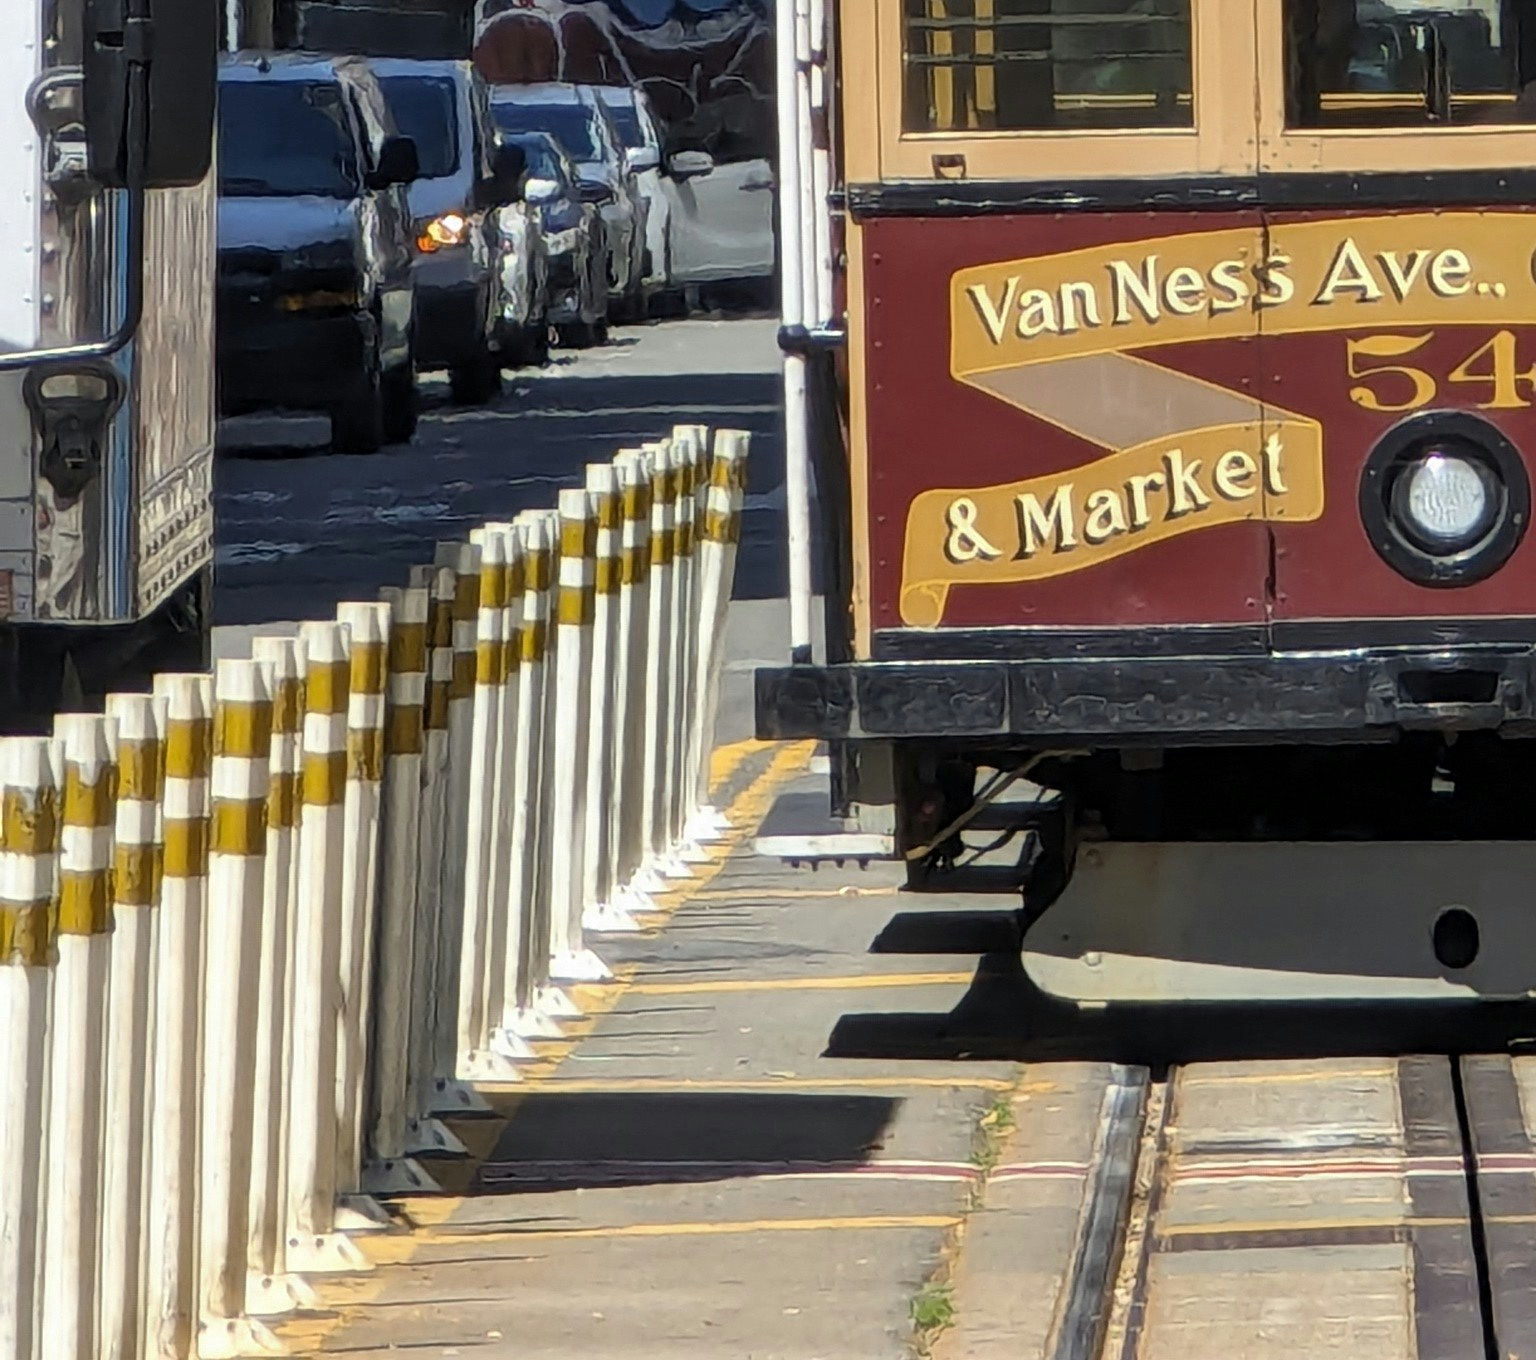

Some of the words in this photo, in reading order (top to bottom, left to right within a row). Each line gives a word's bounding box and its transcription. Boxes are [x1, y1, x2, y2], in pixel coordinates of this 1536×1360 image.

[967, 275, 1102, 346] Van
[1106, 253, 1294, 325] Ness
[943, 496, 1002, 565] &
[1014, 433, 1290, 561] Market
